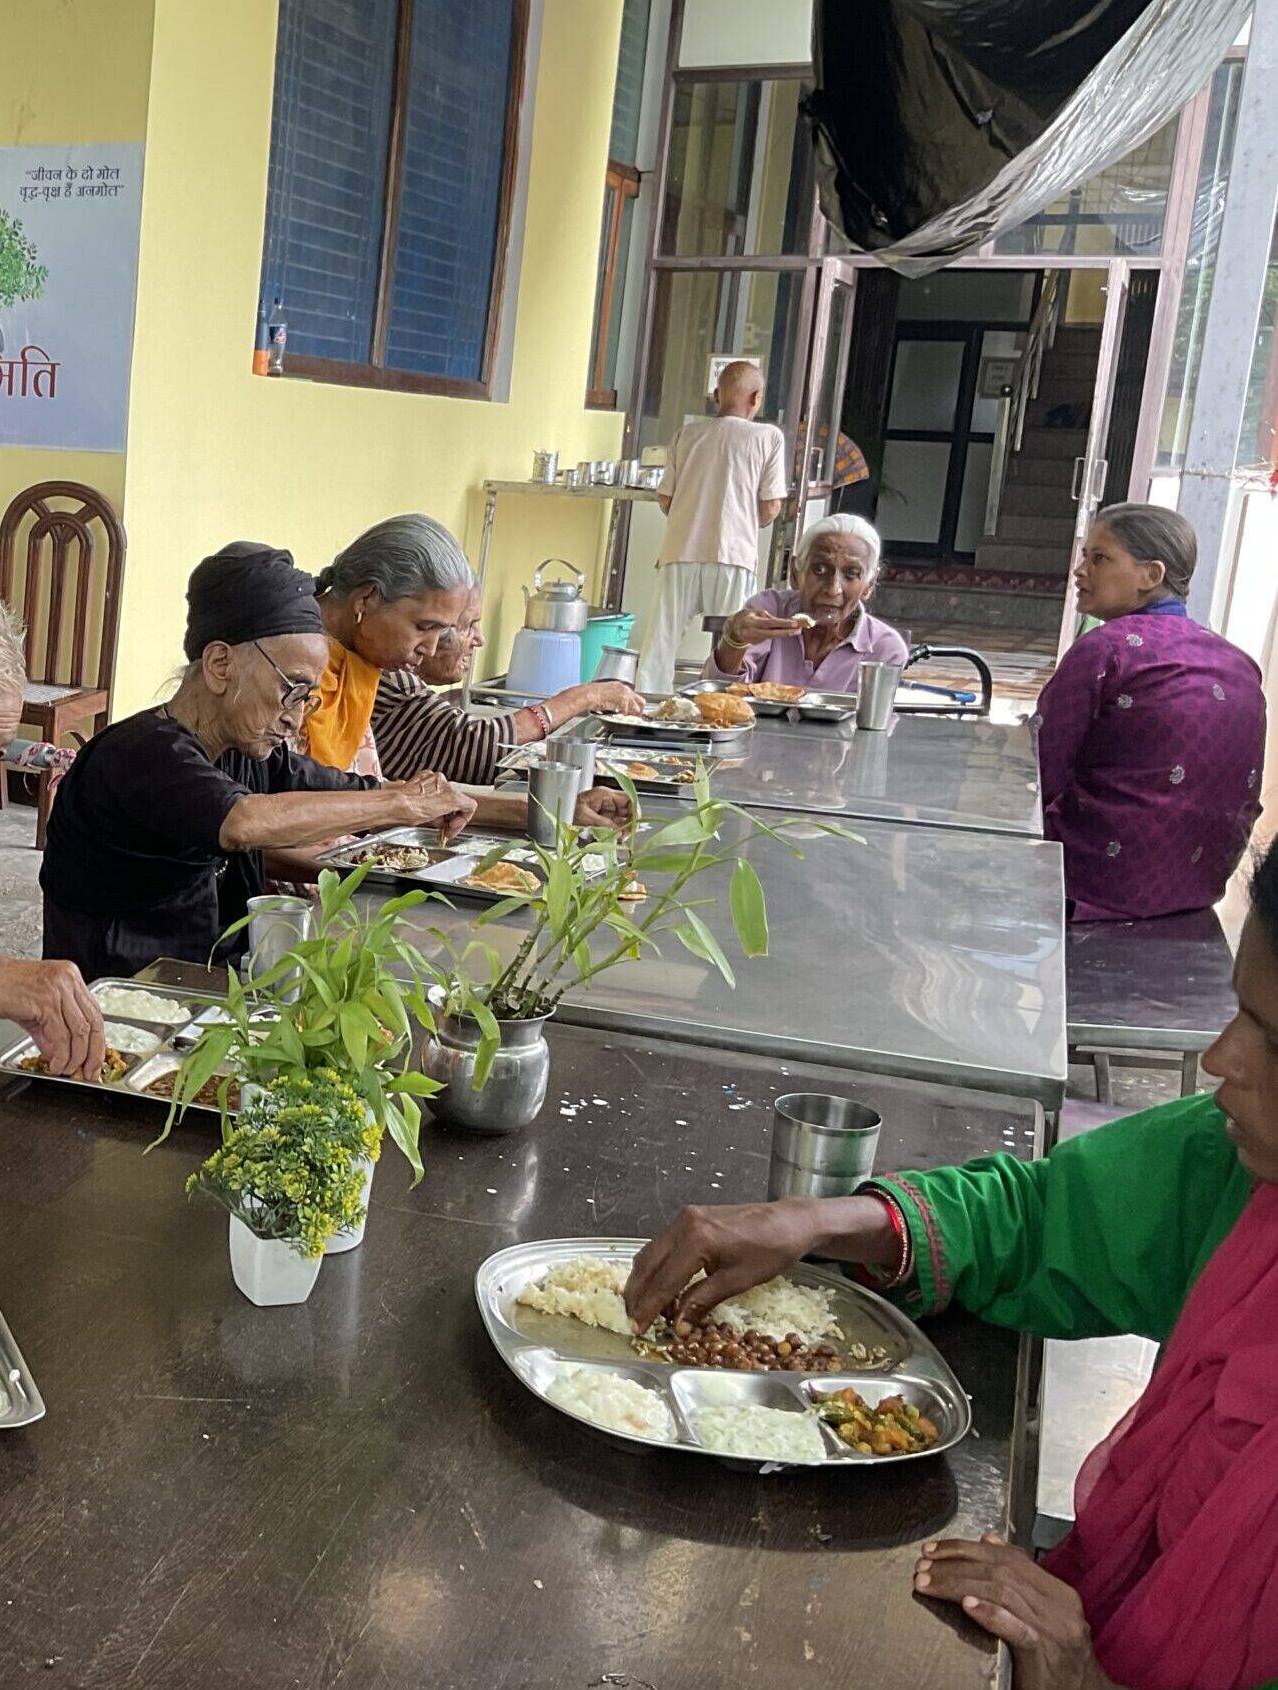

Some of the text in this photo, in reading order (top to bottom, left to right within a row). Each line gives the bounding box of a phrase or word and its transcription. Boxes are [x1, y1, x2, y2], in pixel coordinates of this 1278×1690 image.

[65, 166, 78, 180] के
[82, 165, 93, 180] दो
[97, 165, 120, 180] मोल
